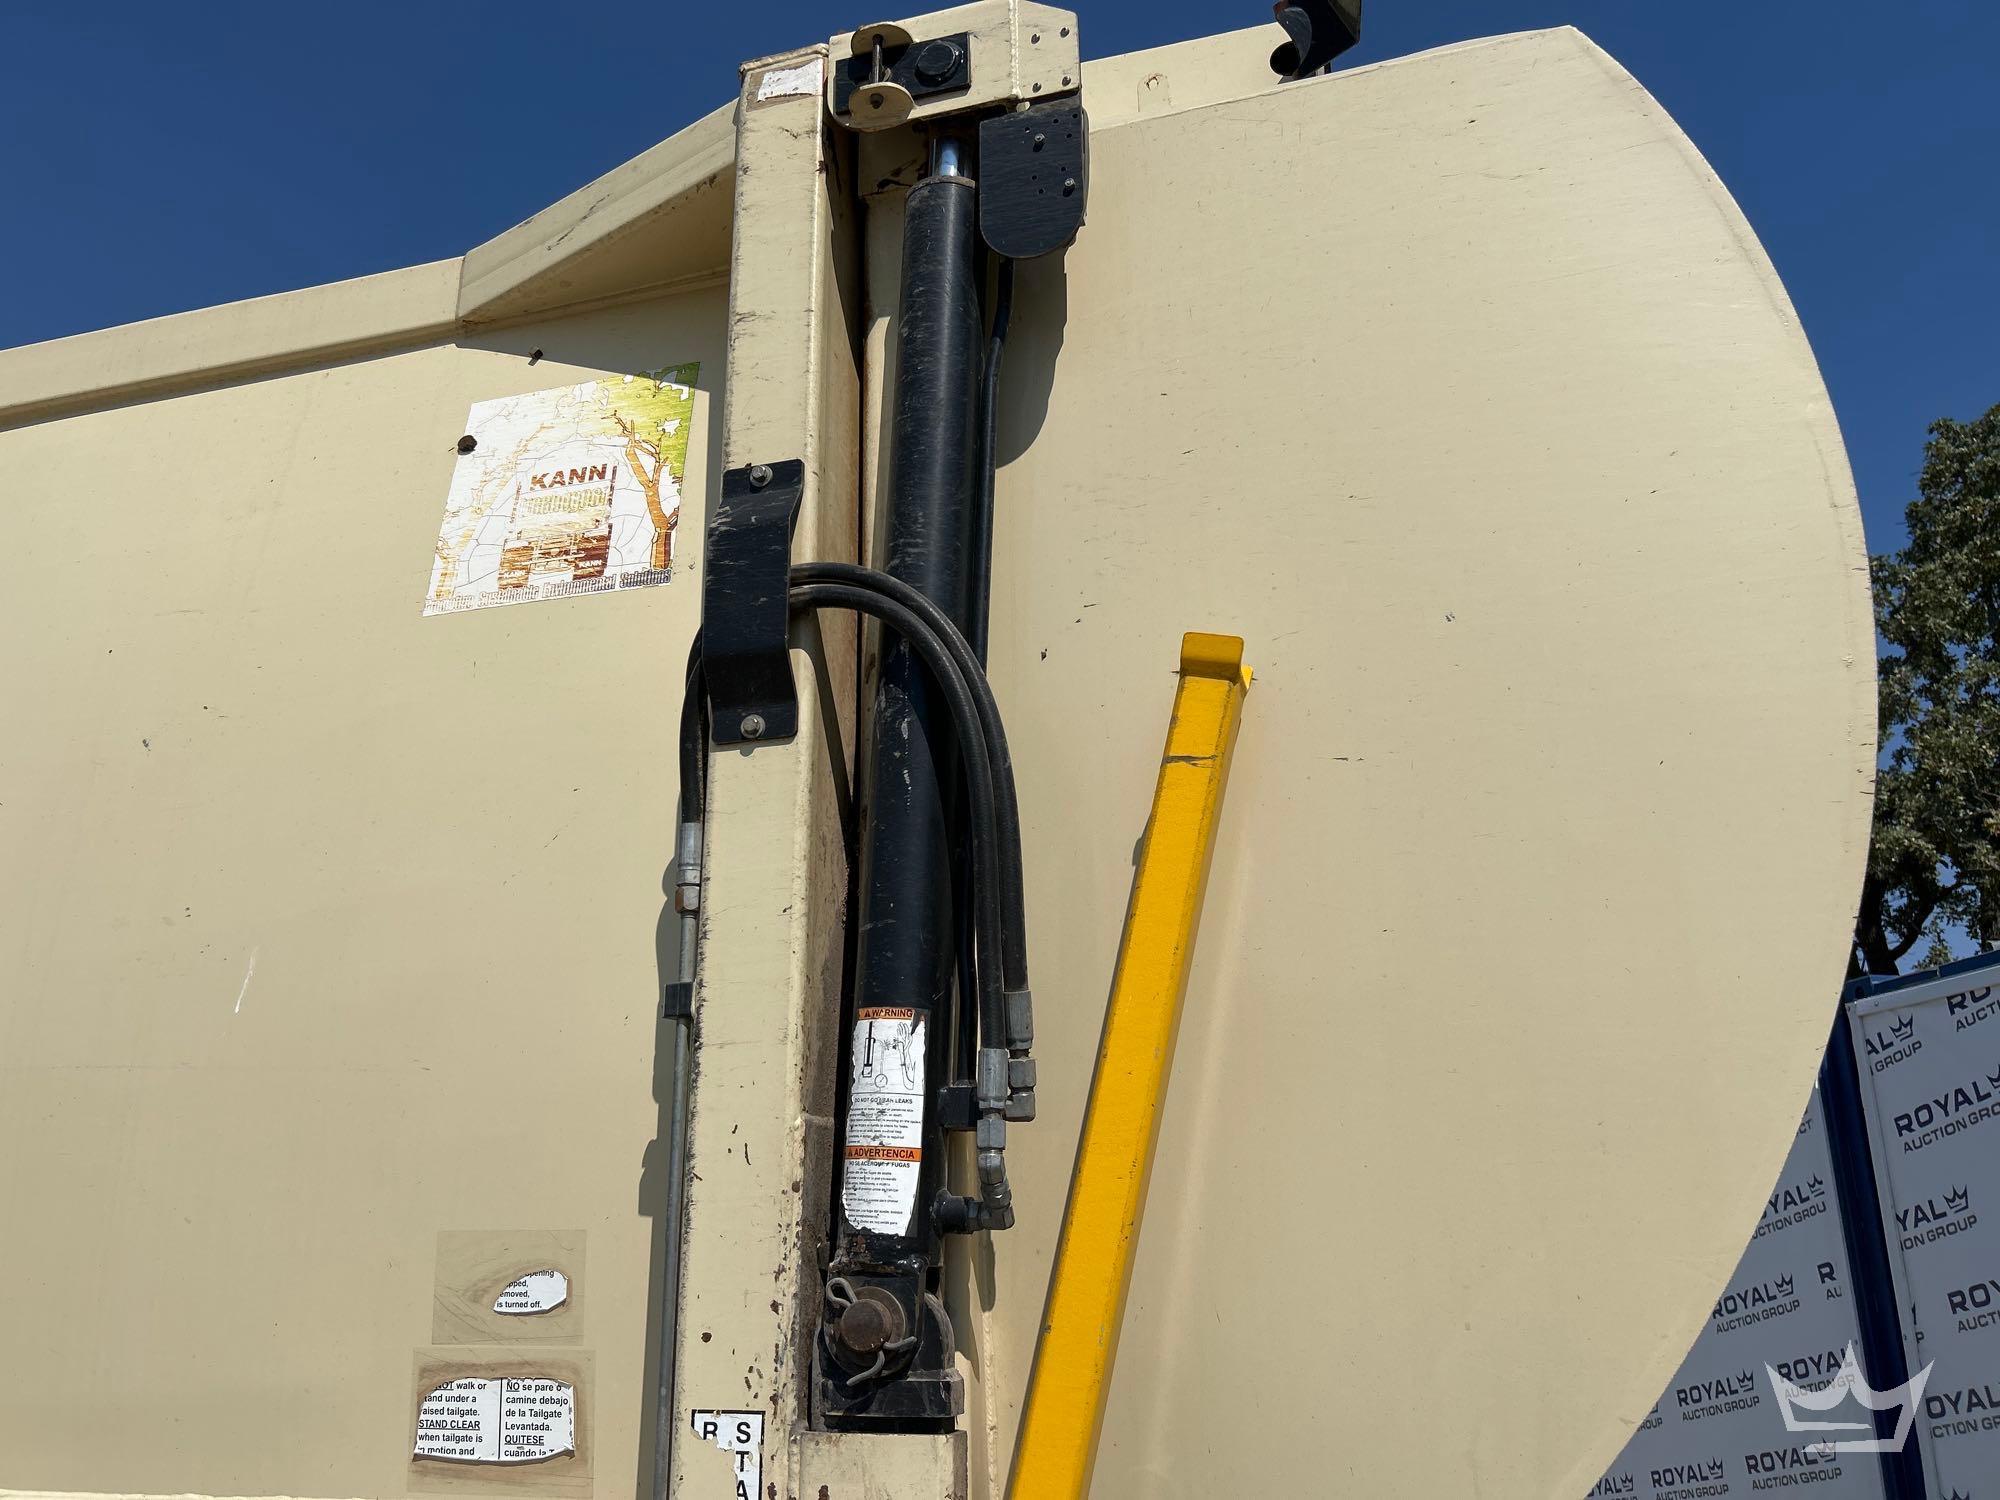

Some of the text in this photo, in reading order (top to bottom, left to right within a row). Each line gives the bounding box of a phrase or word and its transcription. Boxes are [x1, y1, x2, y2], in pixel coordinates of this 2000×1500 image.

[531, 464, 607, 490] KANN
[618, 569, 672, 588] Solutions
[1874, 1040, 1922, 1073] GROUP
[1893, 1081, 1993, 1138] ROYAL
[1904, 1117, 1968, 1154] AUCTION
[854, 1148, 915, 1159] ADVERTENCIA
[1760, 1185, 1810, 1220] YAL
[1793, 1201, 1827, 1224] GROU
[1926, 1214, 1978, 1242] GROUP
[506, 1280, 529, 1288] pped,
[1712, 1283, 1778, 1320] ROYAL
[1716, 1299, 1800, 1334] AUCTION GROUP
[1777, 1348, 1853, 1384] ROYAL
[456, 1382, 476, 1390] walk
[506, 1382, 520, 1392] NO
[534, 1384, 554, 1393] pare
[1676, 1376, 1739, 1408] ROYAL
[1784, 1379, 1834, 1399] AUCTION
[445, 1394, 470, 1402] under
[506, 1396, 568, 1407] camine debajo
[421, 1406, 480, 1418] aised tailgate.
[506, 1408, 562, 1420] de la Tailgate
[1682, 1396, 1760, 1422] AUCTION GROUP
[419, 1420, 480, 1430] STAND CLEAR
[505, 1422, 552, 1432] Levantada.
[1930, 1419, 1978, 1439] CTION
[418, 1432, 483, 1444] when tailgate is
[504, 1434, 544, 1445] QUITESE
[427, 1446, 456, 1454] motion
[458, 1447, 475, 1456] and
[504, 1448, 536, 1457] cuando
[1745, 1446, 1818, 1474] ROYAL
[1650, 1464, 1710, 1488] ROYAL
[1752, 1468, 1842, 1490] AUCTION GROUP
[1696, 1484, 1729, 1498] GROUP
